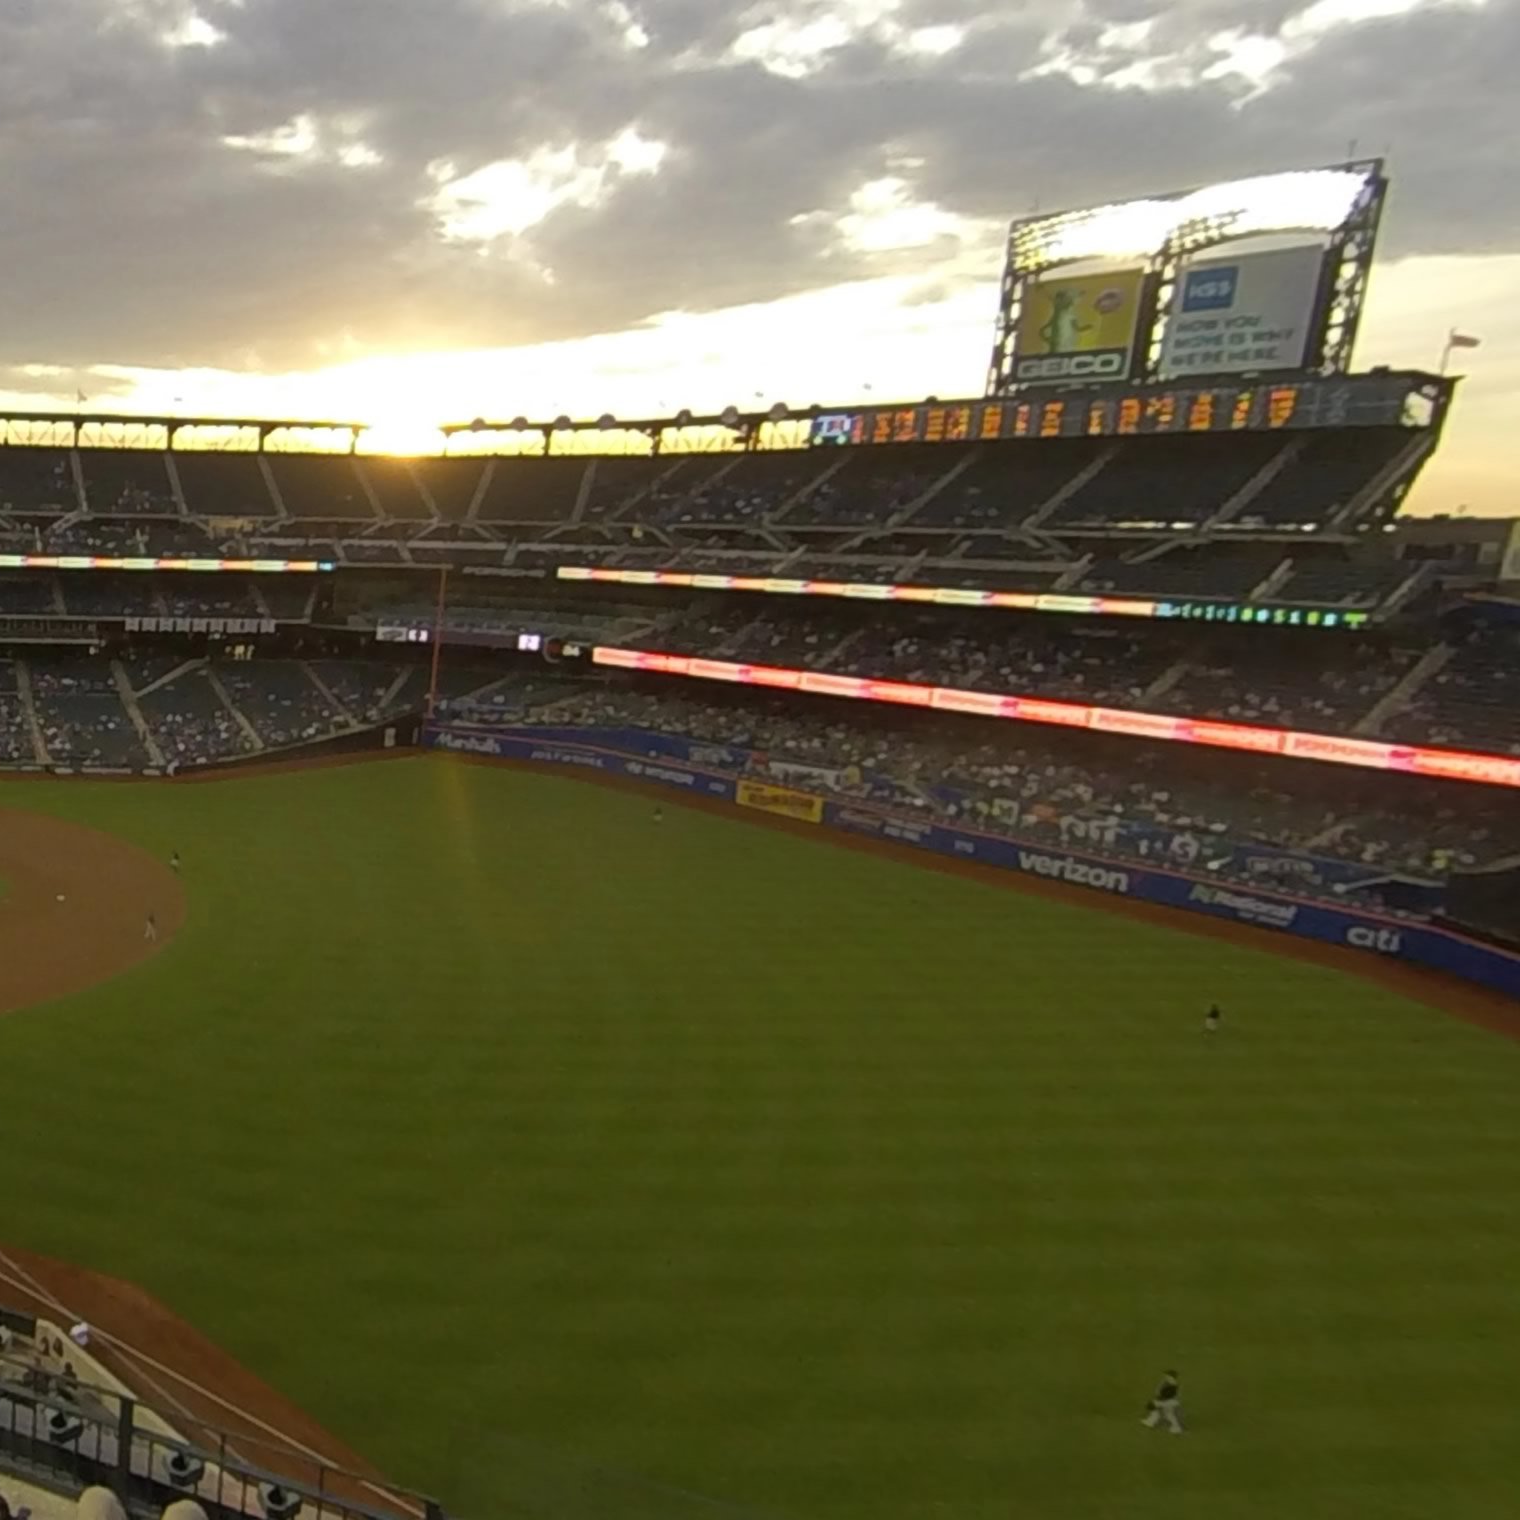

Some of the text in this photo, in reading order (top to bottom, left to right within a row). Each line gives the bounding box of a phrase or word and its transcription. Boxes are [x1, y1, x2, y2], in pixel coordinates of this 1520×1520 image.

[1018, 352, 1122, 379] GEICO
[1017, 850, 1129, 893] verizon
[1346, 926, 1401, 953] citi
